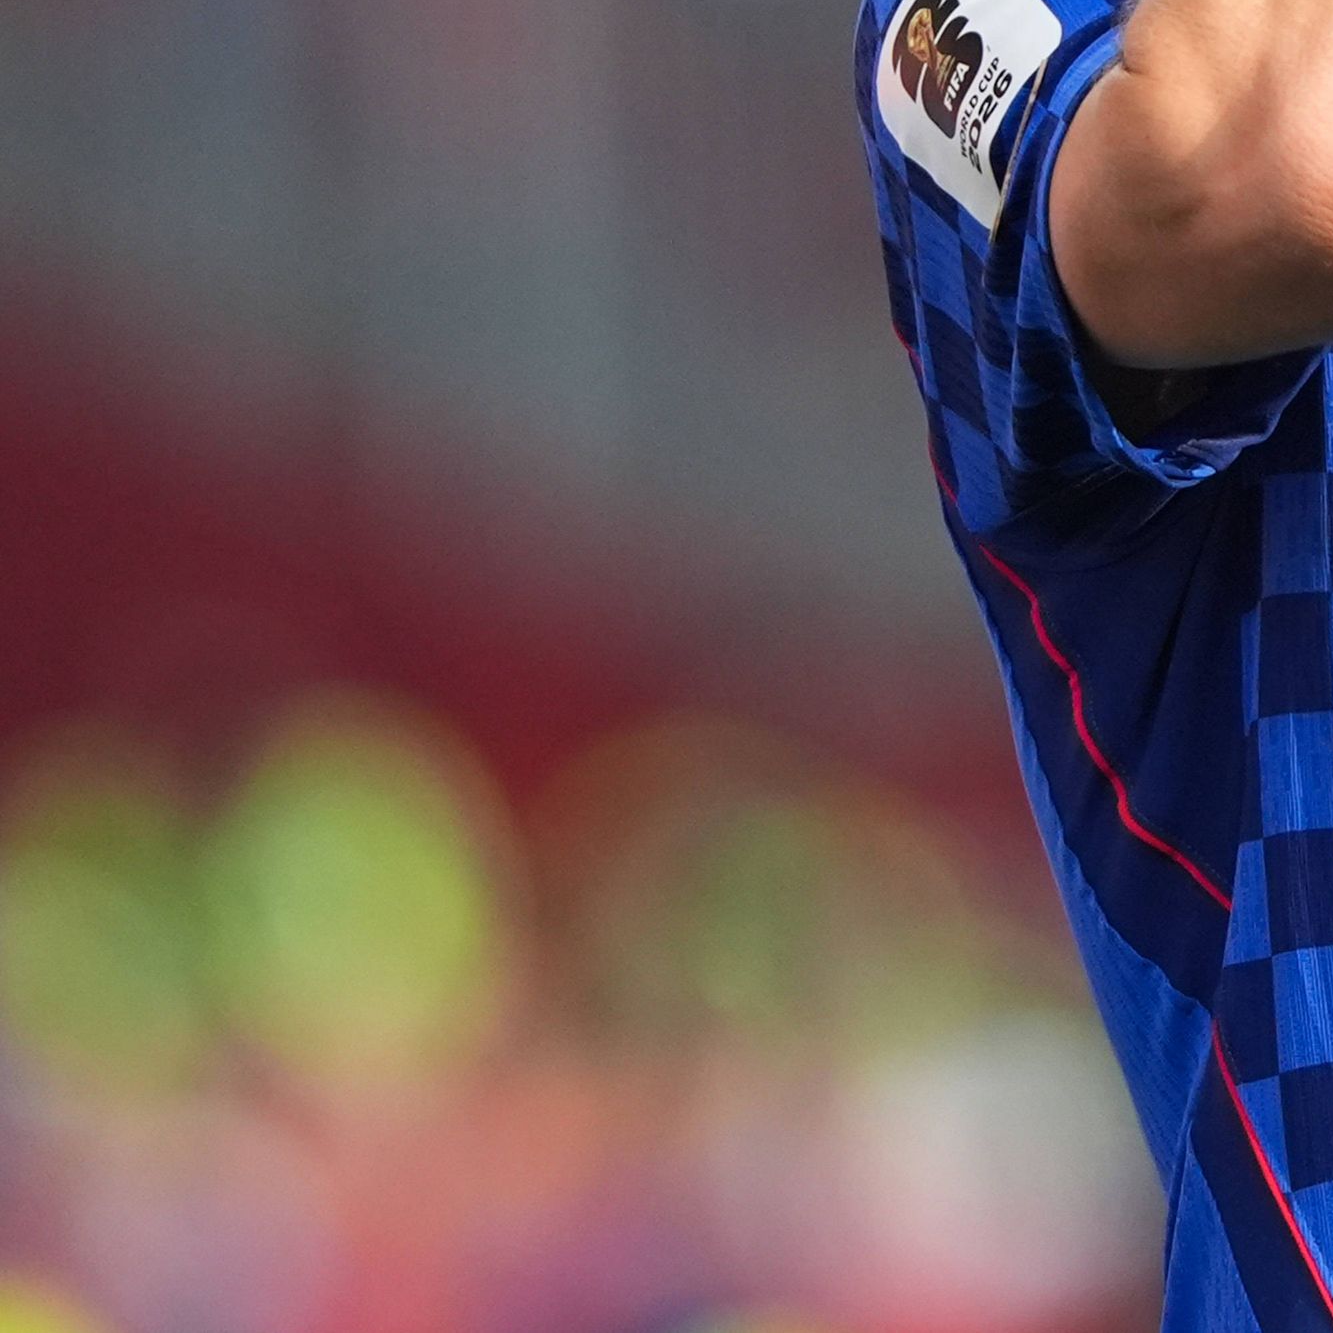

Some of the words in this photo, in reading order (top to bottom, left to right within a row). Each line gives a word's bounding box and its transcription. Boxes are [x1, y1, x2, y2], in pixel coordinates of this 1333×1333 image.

[944, 62, 970, 112] FIFA
[960, 95, 979, 158] WORLD
[978, 57, 999, 93] CUP
[969, 69, 1013, 174] 2026
